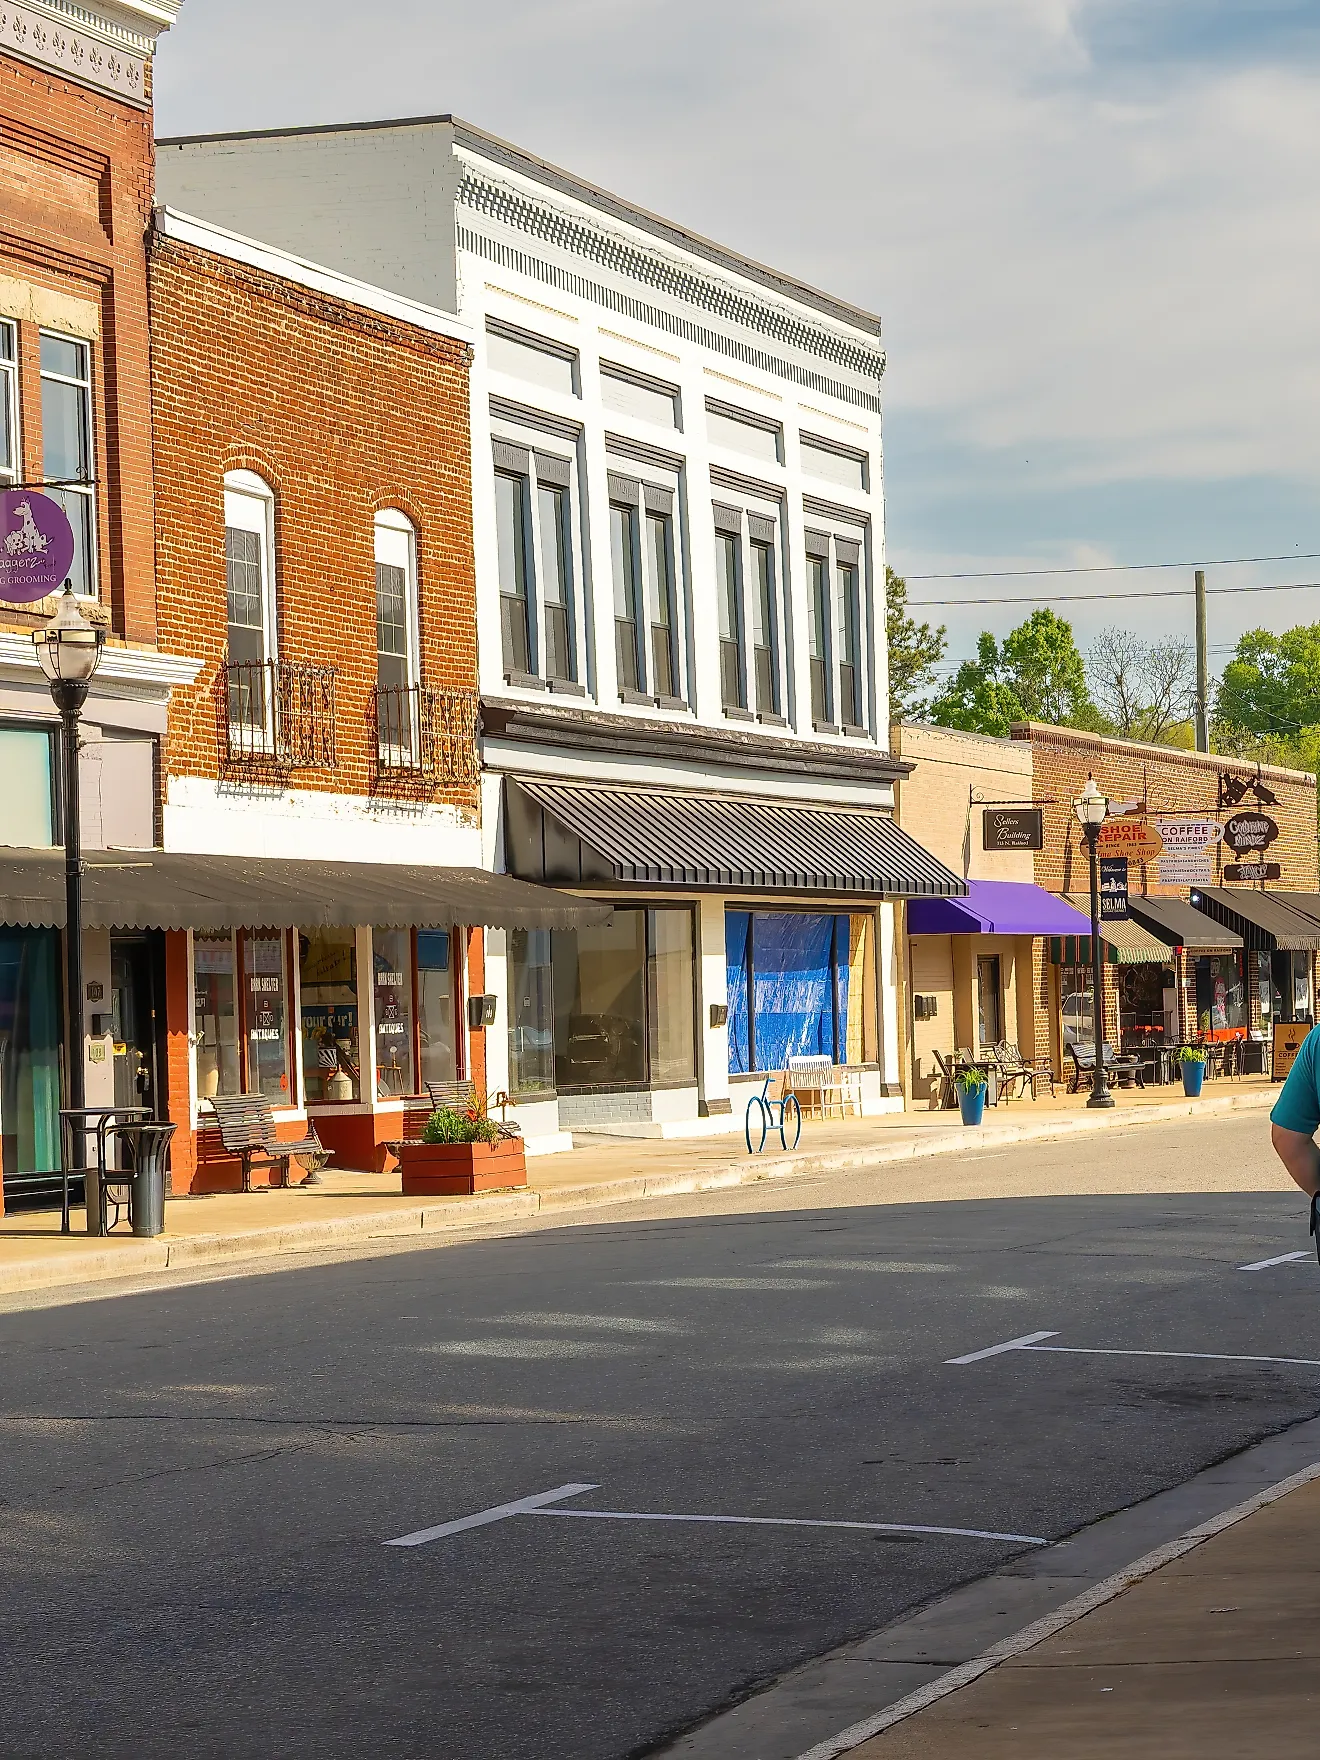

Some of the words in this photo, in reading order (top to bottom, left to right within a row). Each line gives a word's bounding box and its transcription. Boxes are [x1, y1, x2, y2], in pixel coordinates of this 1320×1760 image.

[7, 574, 57, 584] GROOMING
[993, 814, 1020, 828] Sellers
[996, 827, 1032, 841] Building
[1101, 825, 1141, 834] SHOE
[1161, 826, 1208, 836] COFFEE
[1097, 832, 1147, 842] REPAIR
[1114, 849, 1134, 858] Shoe
[1135, 848, 1156, 857] Shop
[1102, 897, 1127, 910] SELMA
[250, 1028, 280, 1041] ANTIQUES
